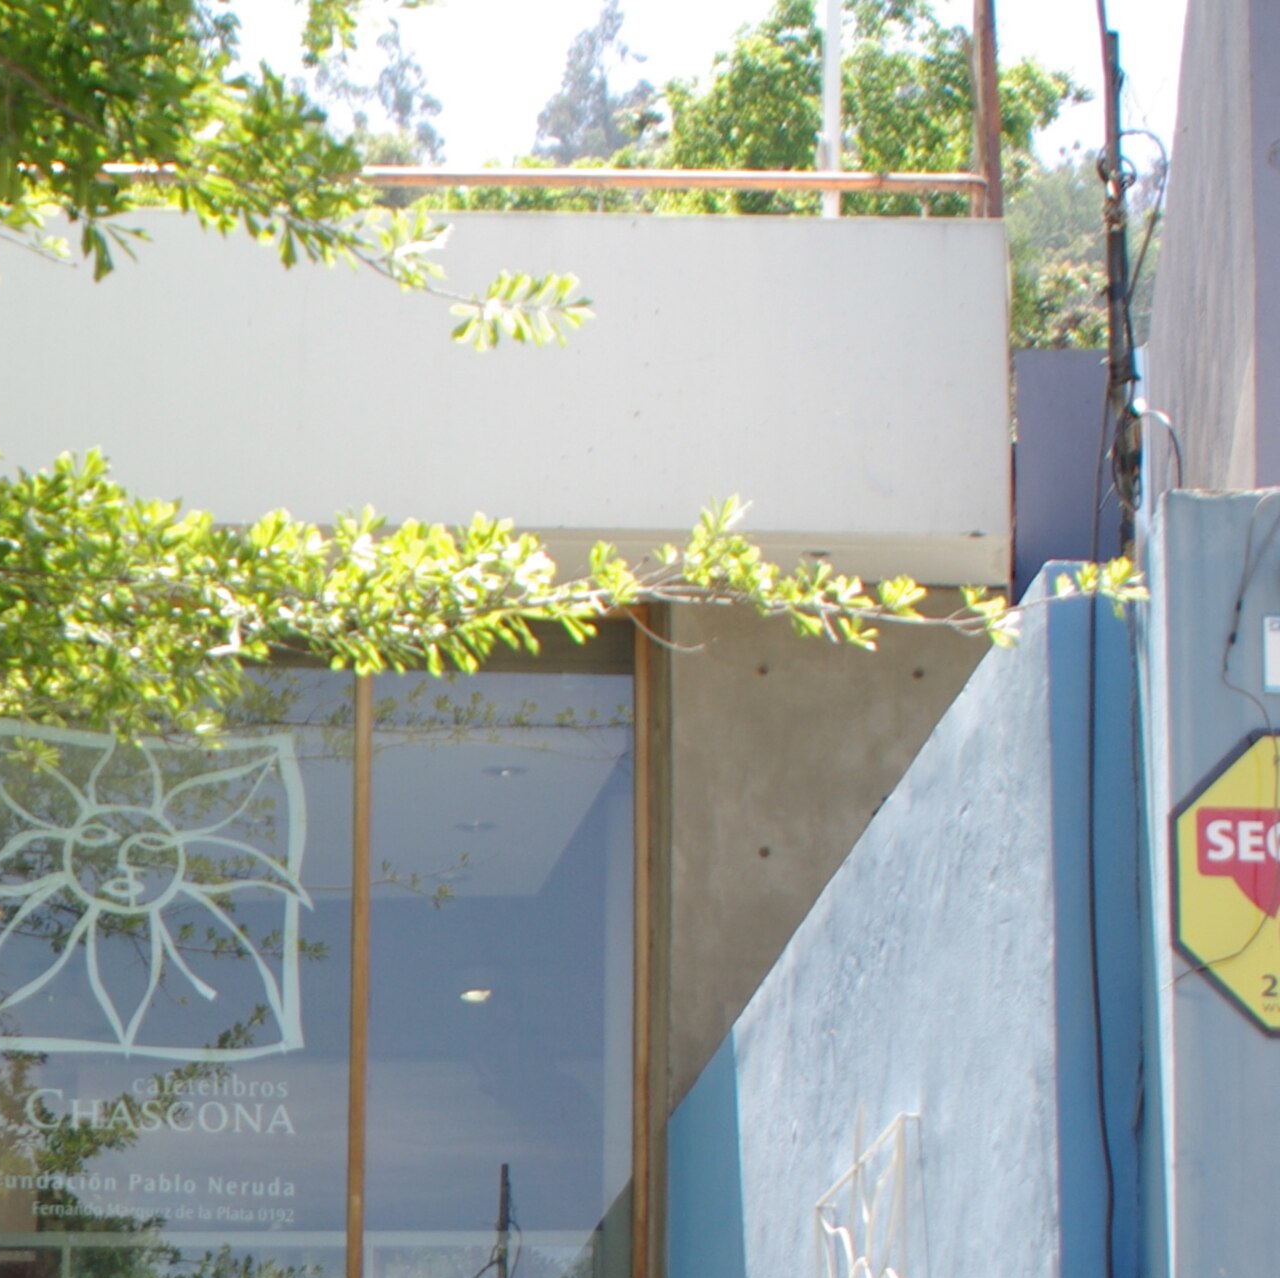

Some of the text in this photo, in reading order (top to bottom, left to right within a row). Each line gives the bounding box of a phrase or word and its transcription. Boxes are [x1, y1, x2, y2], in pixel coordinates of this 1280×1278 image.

[24, 1088, 297, 1135] CHASCONA
[128, 1173, 197, 1194] Pablo
[207, 1176, 295, 1197] Neruda
[31, 1201, 103, 1216] Fernando
[175, 1204, 194, 1219] de
[198, 1204, 212, 1220] la
[216, 1206, 254, 1222] Plata
[258, 1207, 295, 1223] 0192
